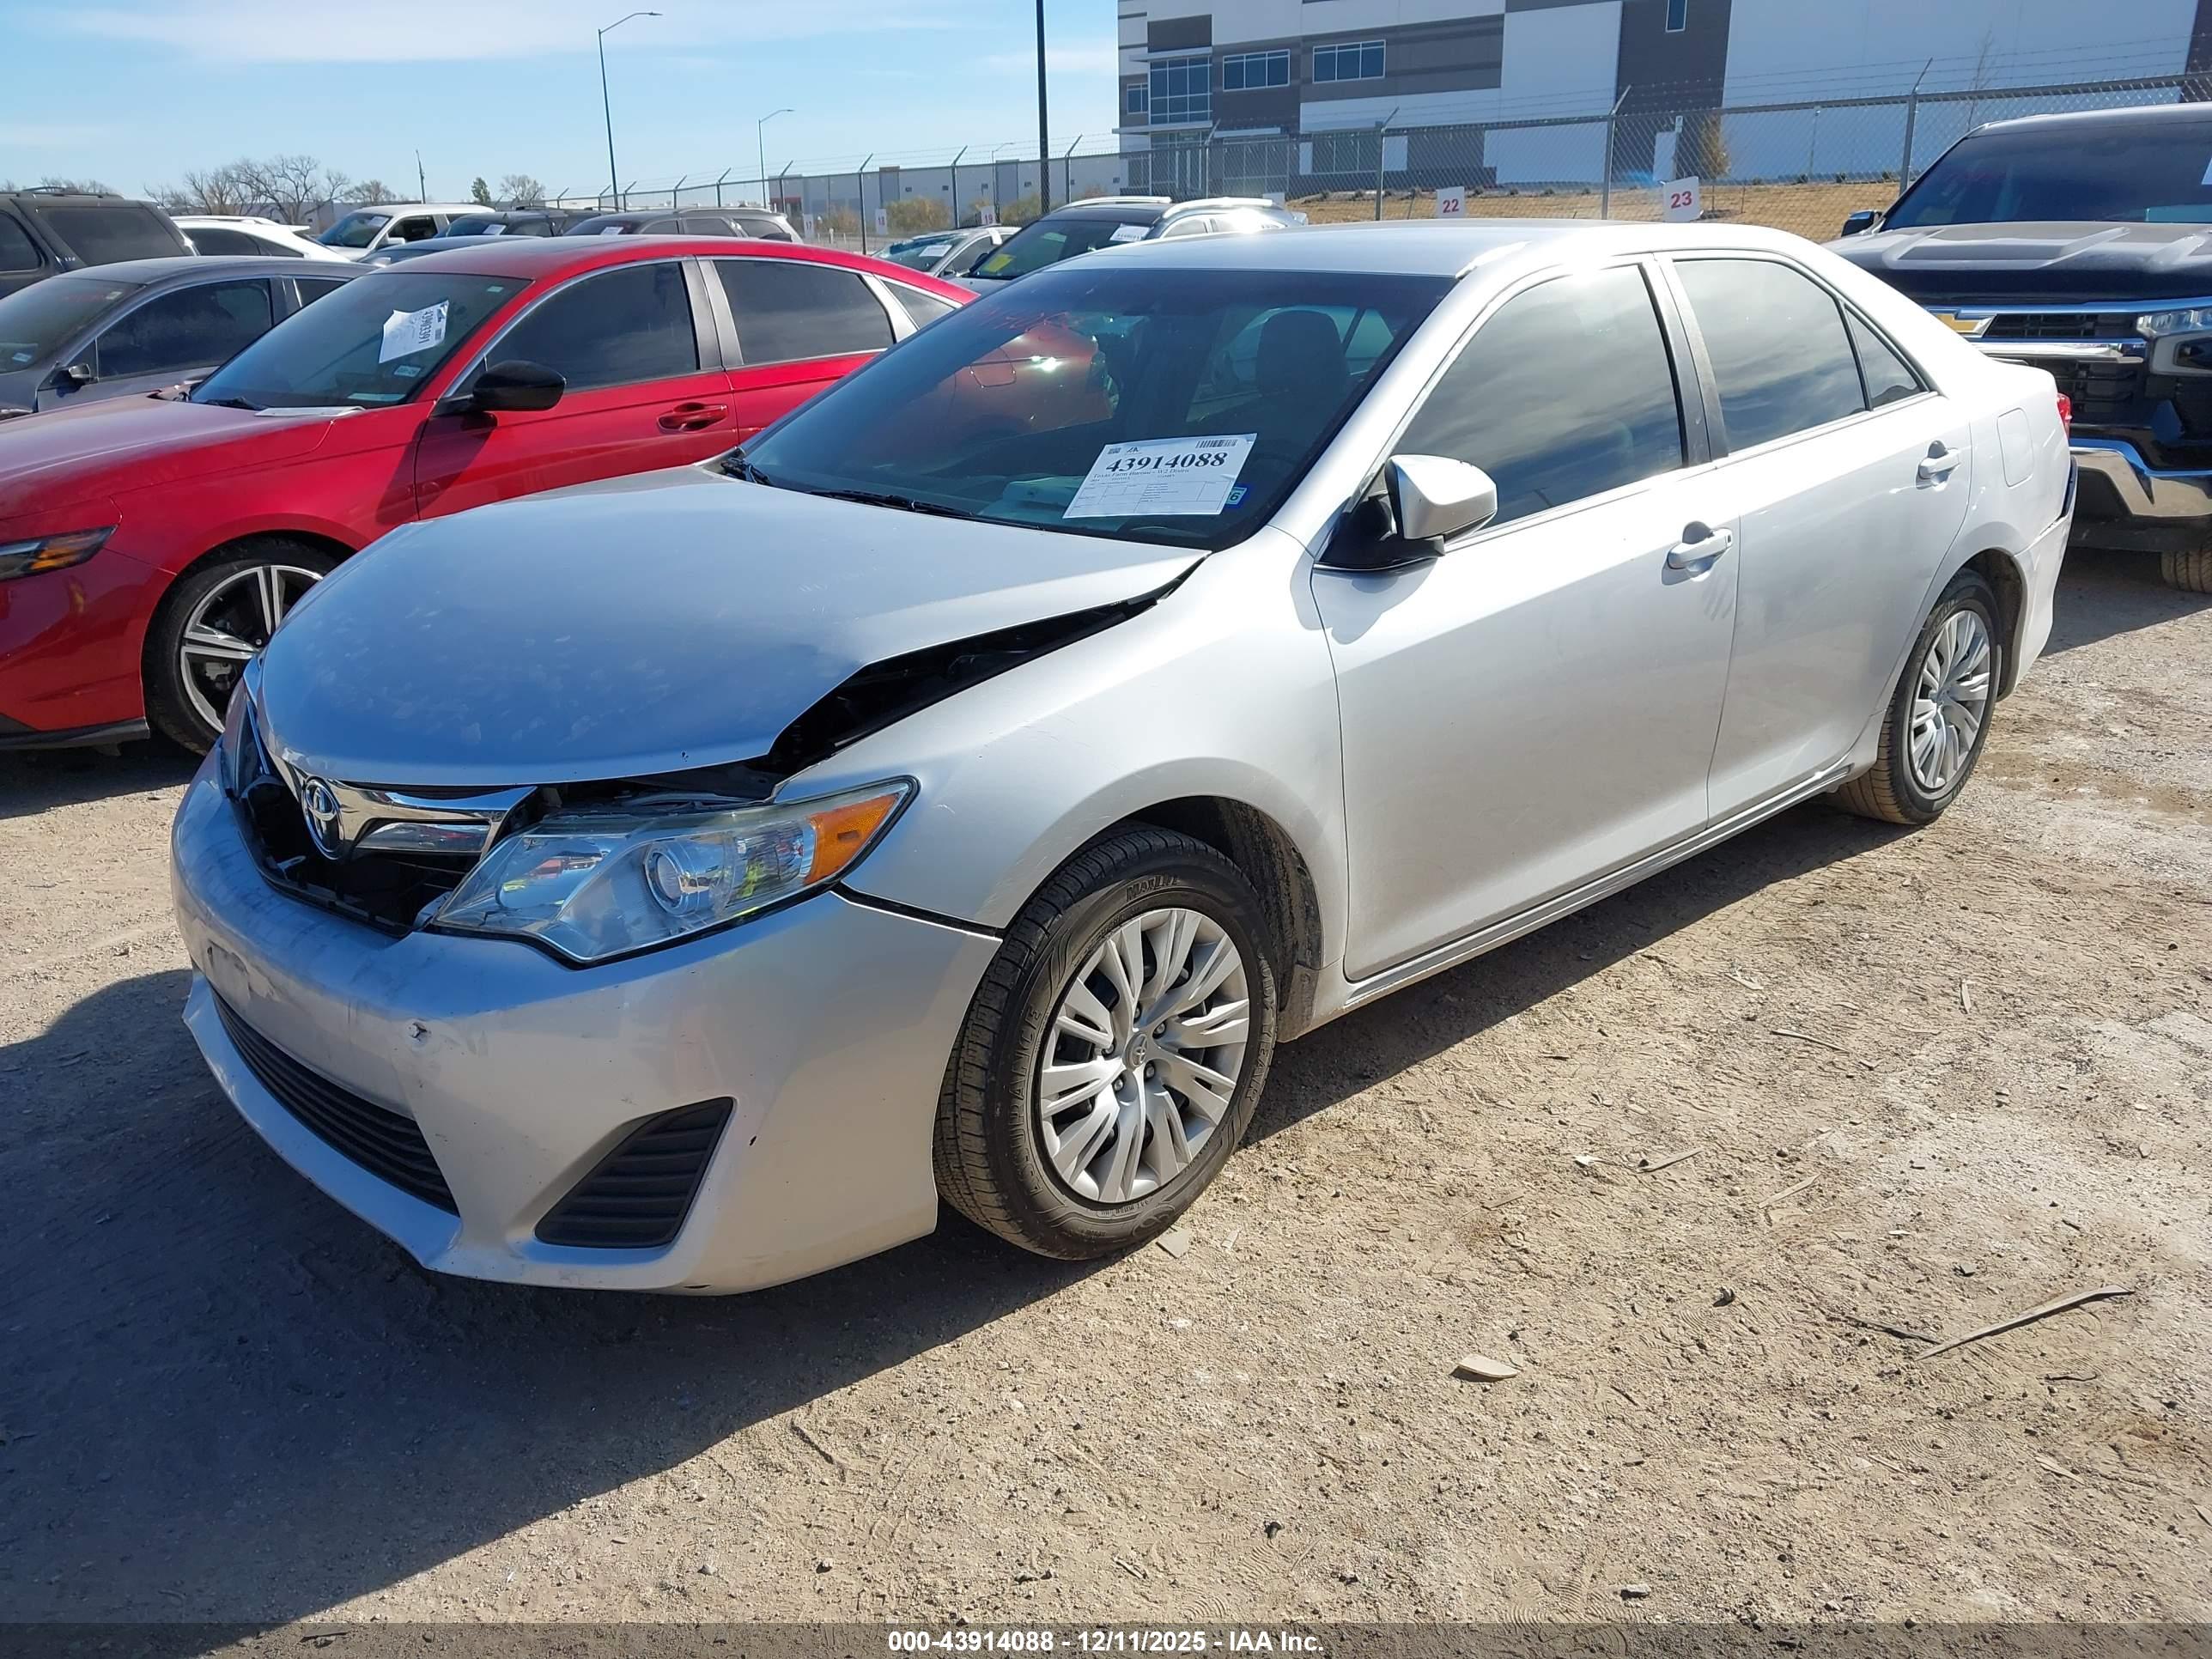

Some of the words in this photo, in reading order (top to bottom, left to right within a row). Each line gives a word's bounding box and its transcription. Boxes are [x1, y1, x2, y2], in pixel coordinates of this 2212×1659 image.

[1443, 198, 1460, 213] 22
[1670, 191, 1693, 210] 23
[1106, 452, 1228, 472] 43914088
